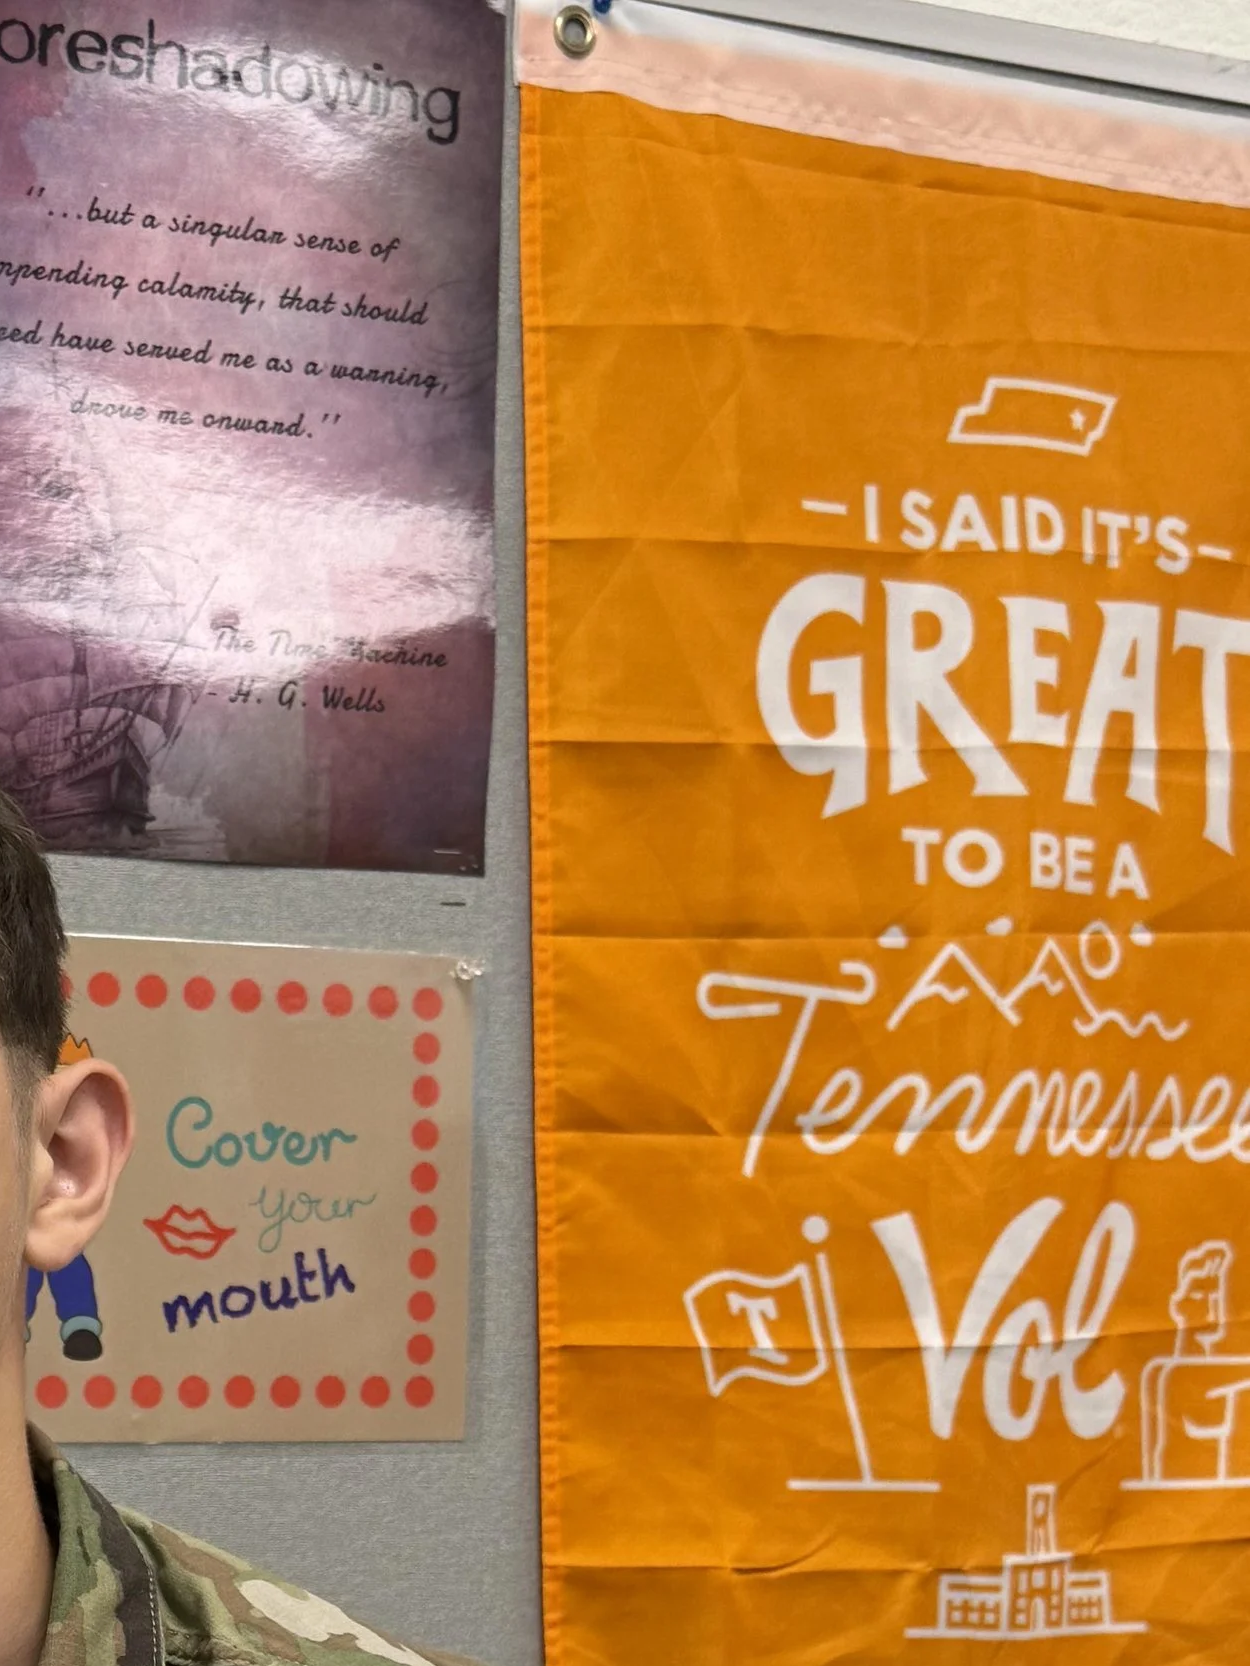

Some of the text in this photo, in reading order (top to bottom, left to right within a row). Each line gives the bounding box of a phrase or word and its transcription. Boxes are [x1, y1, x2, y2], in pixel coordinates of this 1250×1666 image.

[142, 214, 161, 230] a
[168, 216, 287, 247] singular
[293, 231, 361, 256] sense
[370, 237, 401, 263] of
[137, 271, 264, 314] calamity,
[279, 285, 337, 315] that
[341, 292, 429, 326] should
[51, 322, 116, 353] have
[124, 339, 212, 365] served
[219, 350, 258, 369] me
[266, 357, 294, 374] as
[304, 360, 323, 377] a
[330, 363, 450, 398] warning,
[70, 387, 149, 422] drove
[156, 408, 194, 426] me
[863, 484, 1191, 575] I SAID IT'S
[229, 679, 263, 704] H.
[278, 681, 307, 711] G.
[322, 685, 386, 713] Wells
[756, 572, 1250, 857] GREAT
[901, 826, 1151, 900] TO BE A
[166, 1096, 358, 1169] Cover
[250, 1185, 377, 1254] your
[162, 1248, 356, 1334] mouth
[871, 1197, 1136, 1441] Vol
[726, 1292, 790, 1365] T
